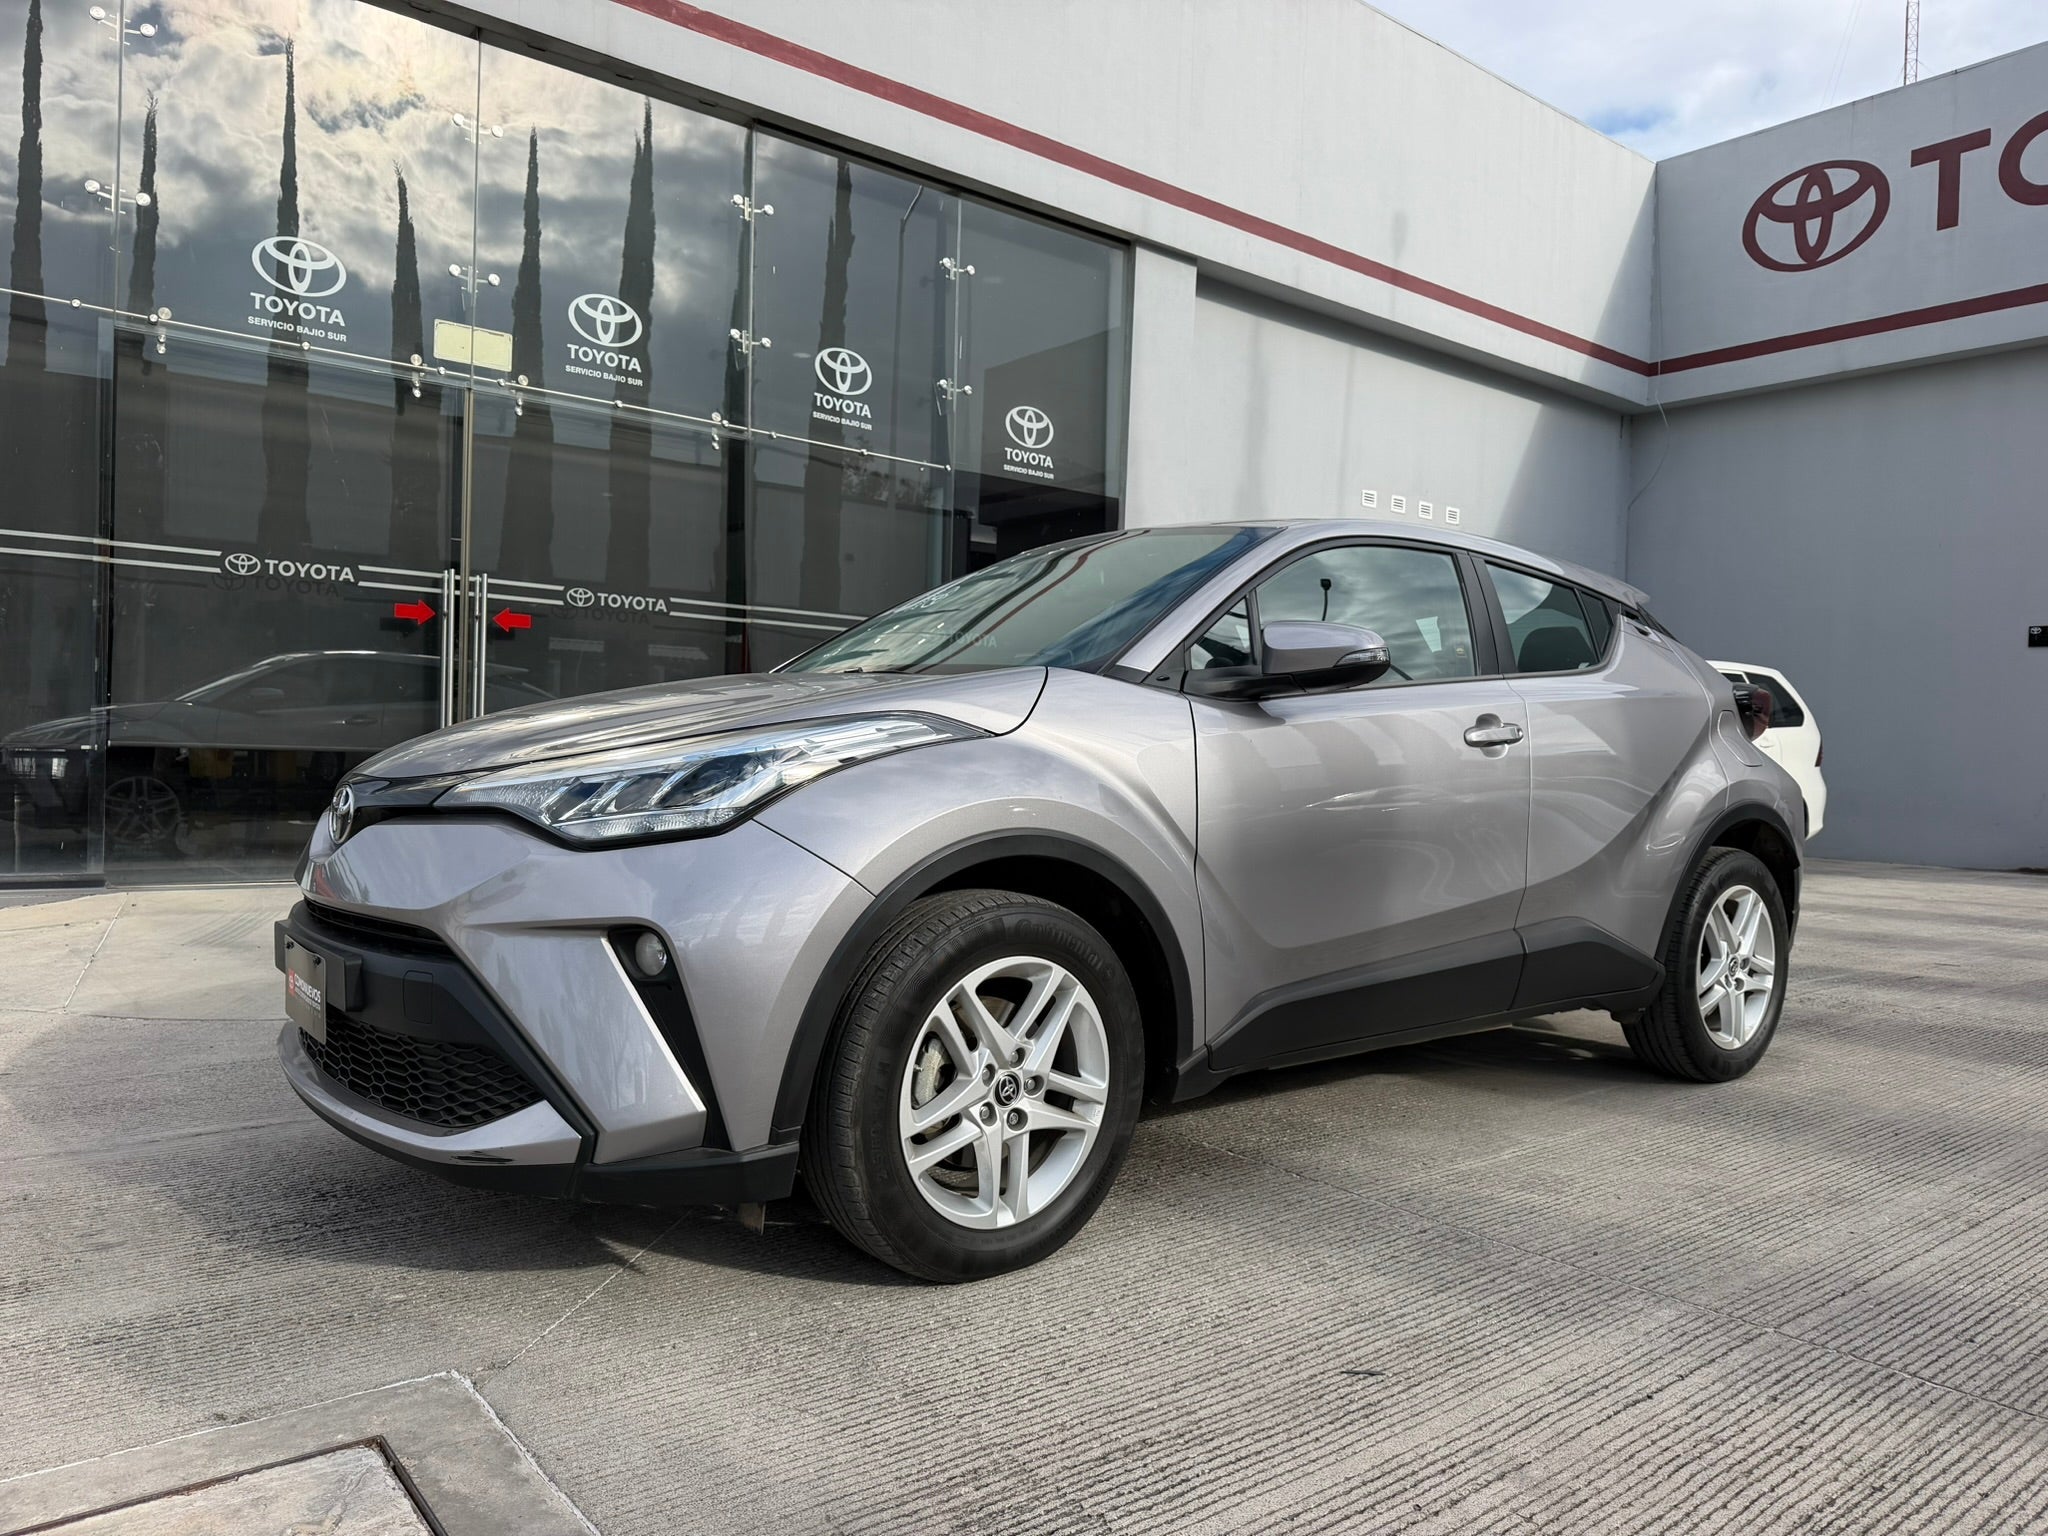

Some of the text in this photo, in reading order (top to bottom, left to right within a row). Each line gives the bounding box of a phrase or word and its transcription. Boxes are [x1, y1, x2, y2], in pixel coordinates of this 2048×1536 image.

[250, 292, 345, 327] TOYOTA
[247, 316, 347, 342] SERVICIO BAJIO SUR
[567, 344, 642, 373] TOYOTA
[565, 365, 643, 387] SERVICIO BAJIO SUR
[813, 392, 872, 419] TOYOTA
[812, 411, 841, 424] SERVICIO
[861, 422, 872, 431] SUR
[1004, 447, 1054, 469] TOYOTA
[264, 559, 355, 583] TOYOTA
[597, 592, 668, 613] TOYOTA
